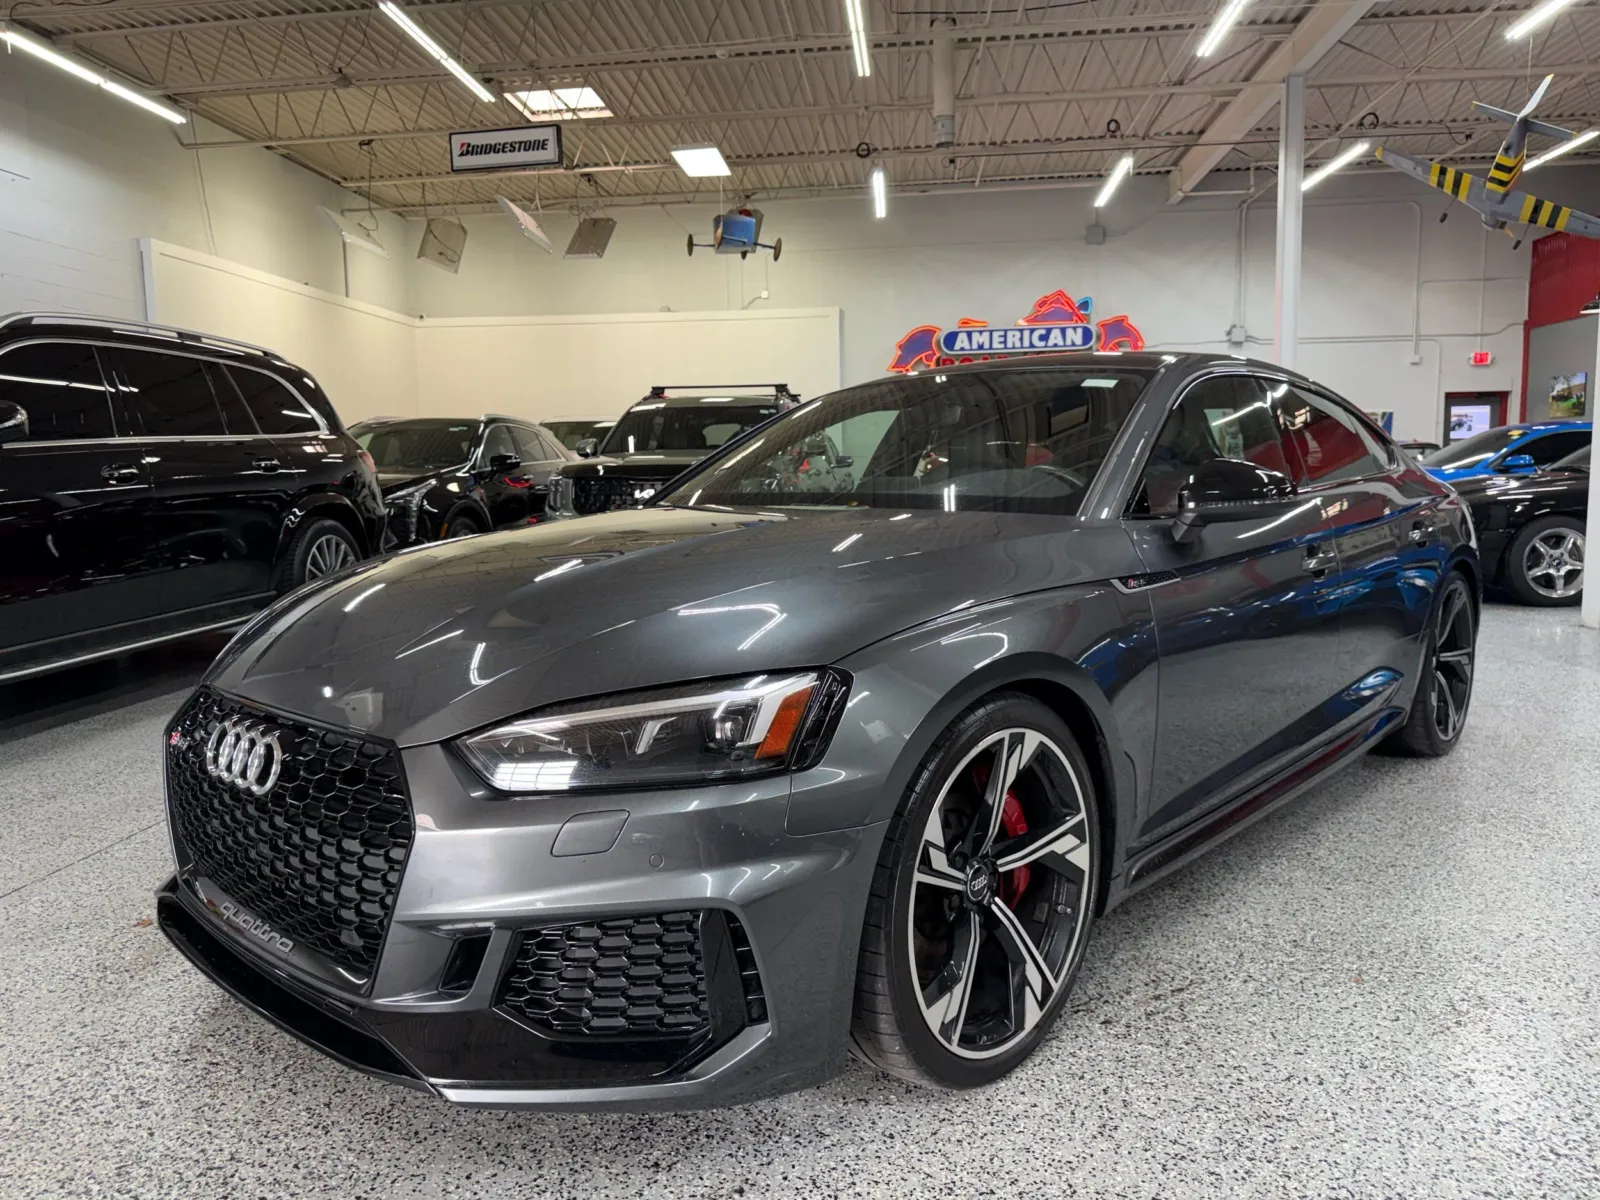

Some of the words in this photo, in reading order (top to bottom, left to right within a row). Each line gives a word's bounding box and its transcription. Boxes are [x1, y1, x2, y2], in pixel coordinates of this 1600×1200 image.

[458, 138, 550, 157] BRIDGESTONE
[953, 327, 1084, 351] AMERICAN
[219, 902, 294, 953] quattro
